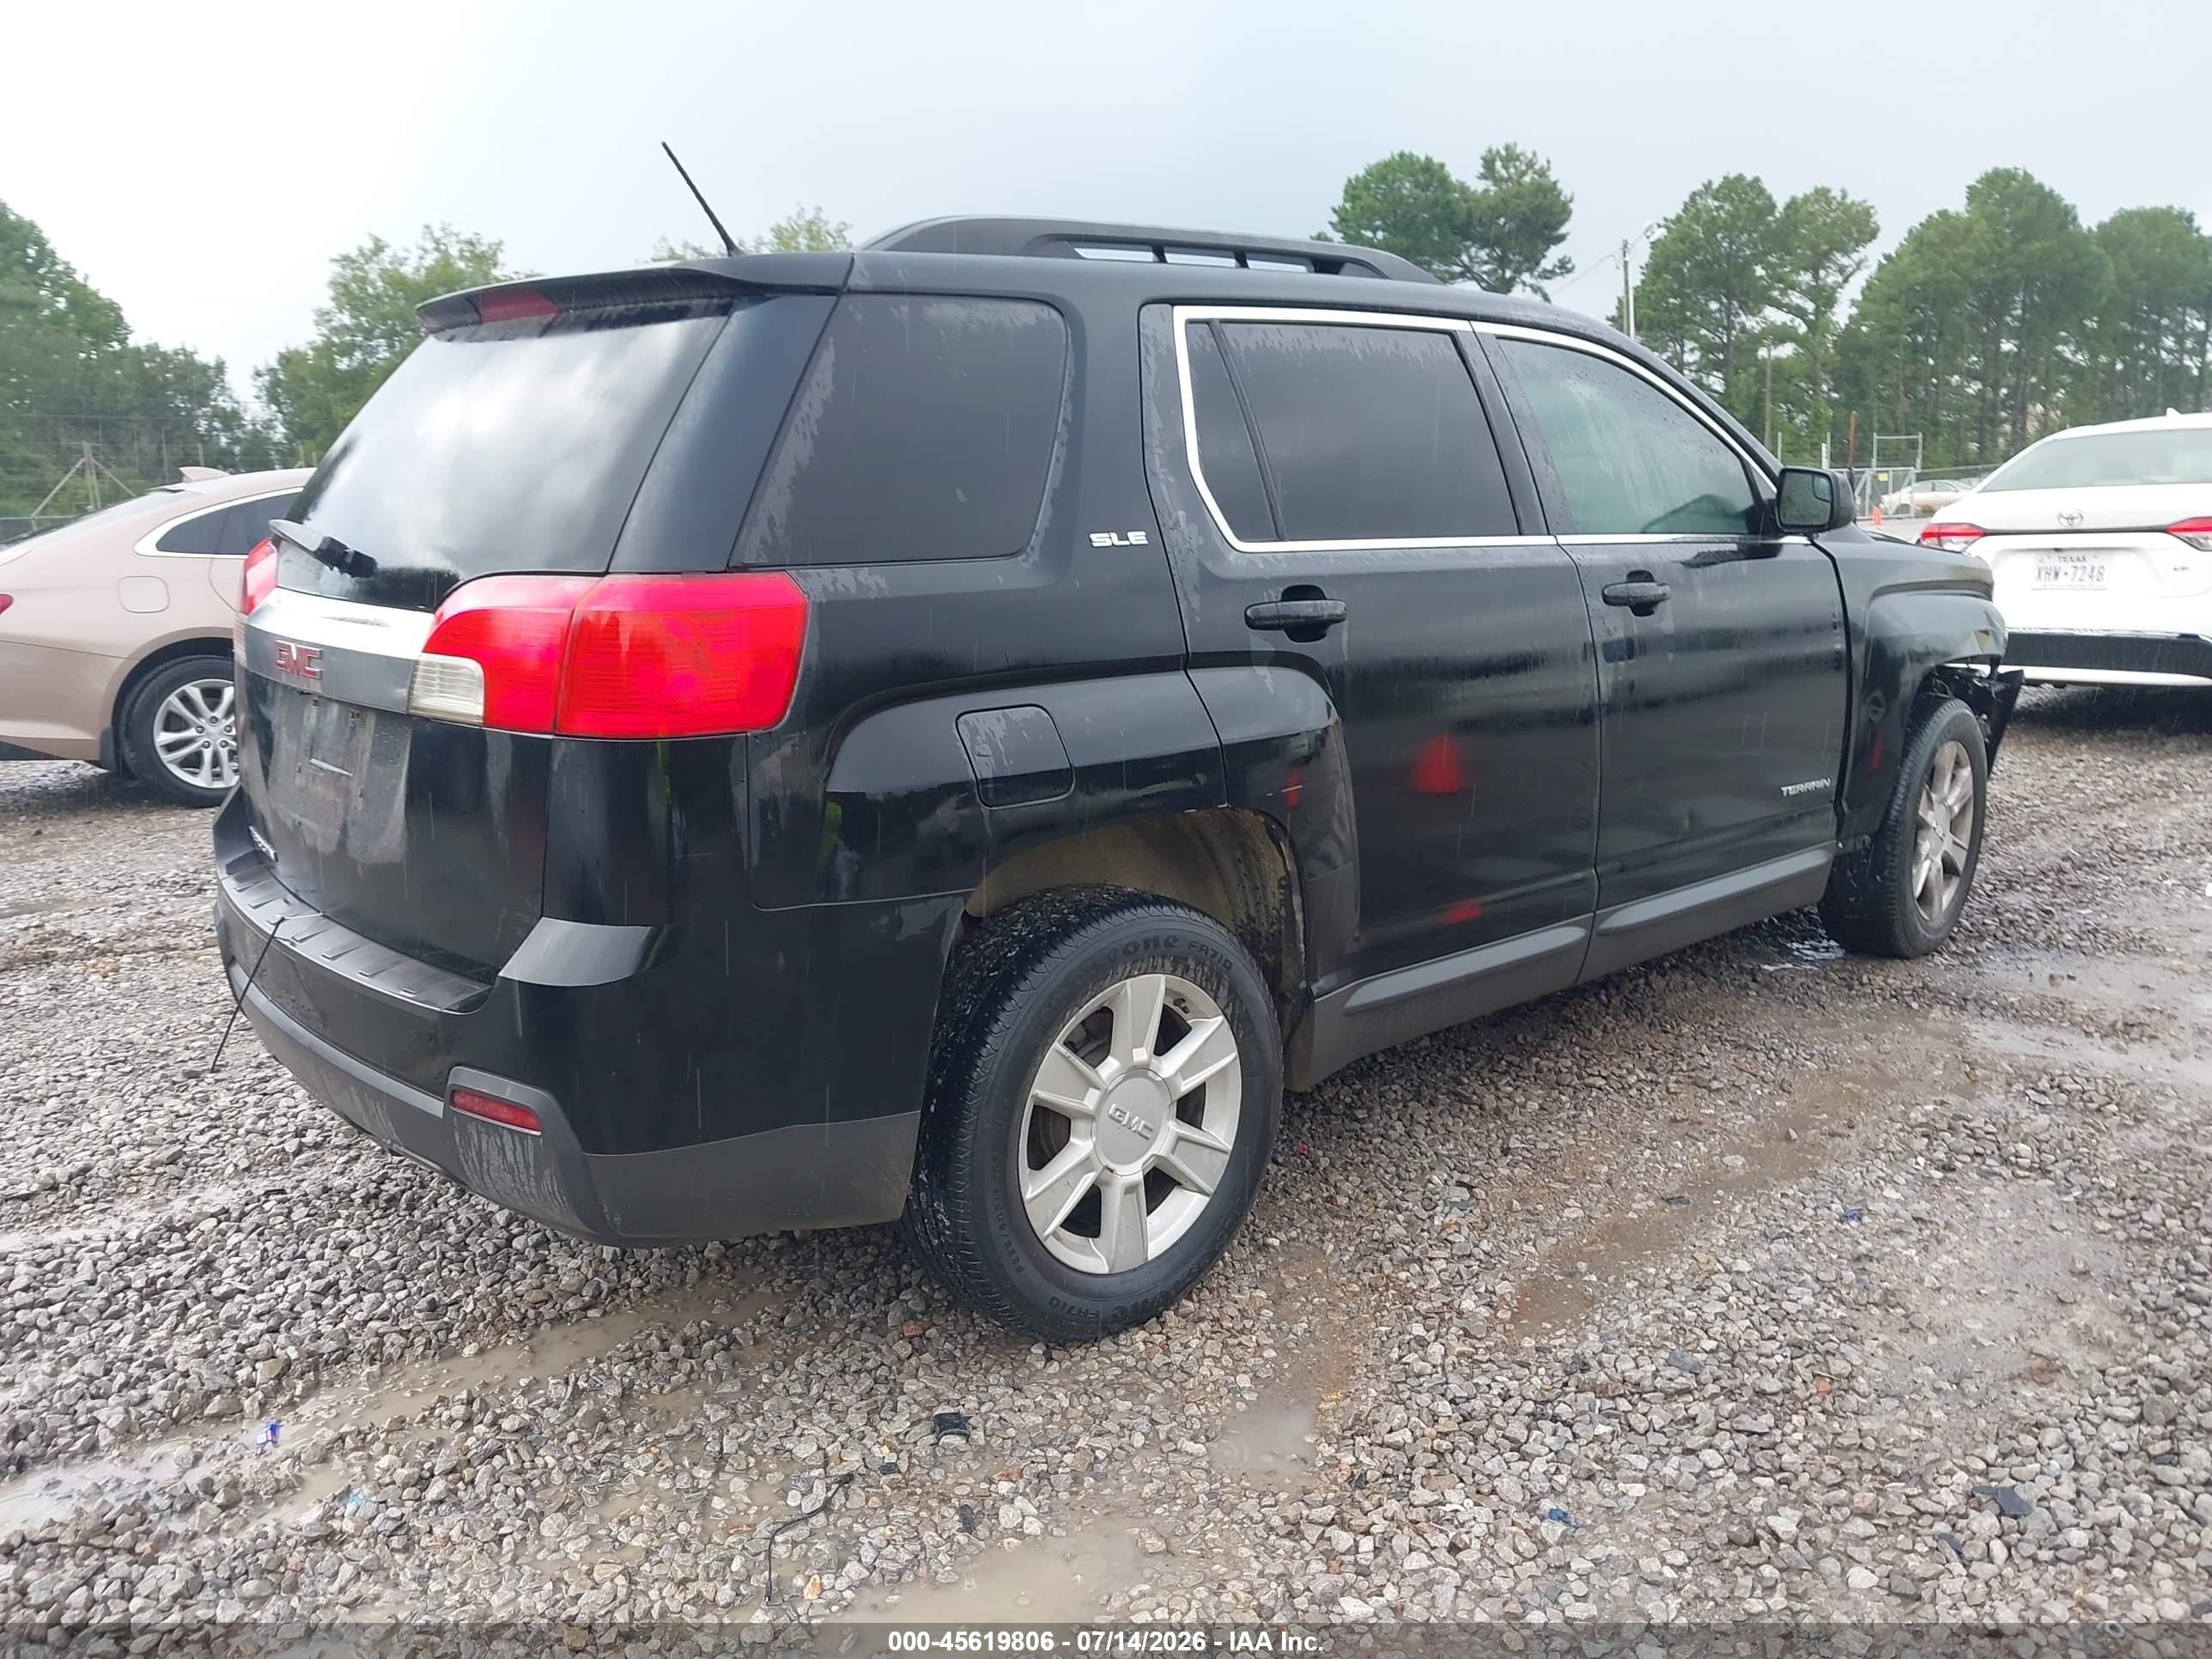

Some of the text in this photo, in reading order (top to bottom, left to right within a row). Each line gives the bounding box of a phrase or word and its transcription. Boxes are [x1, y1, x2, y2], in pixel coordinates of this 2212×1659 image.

[1089, 531, 1149, 547] SLE
[2057, 555, 2088, 563] TEXAS
[275, 639, 325, 680] GMC
[1780, 776, 1832, 797] TERRAIN
[1188, 939, 1233, 971] FR710
[1108, 1103, 1155, 1141] GMC
